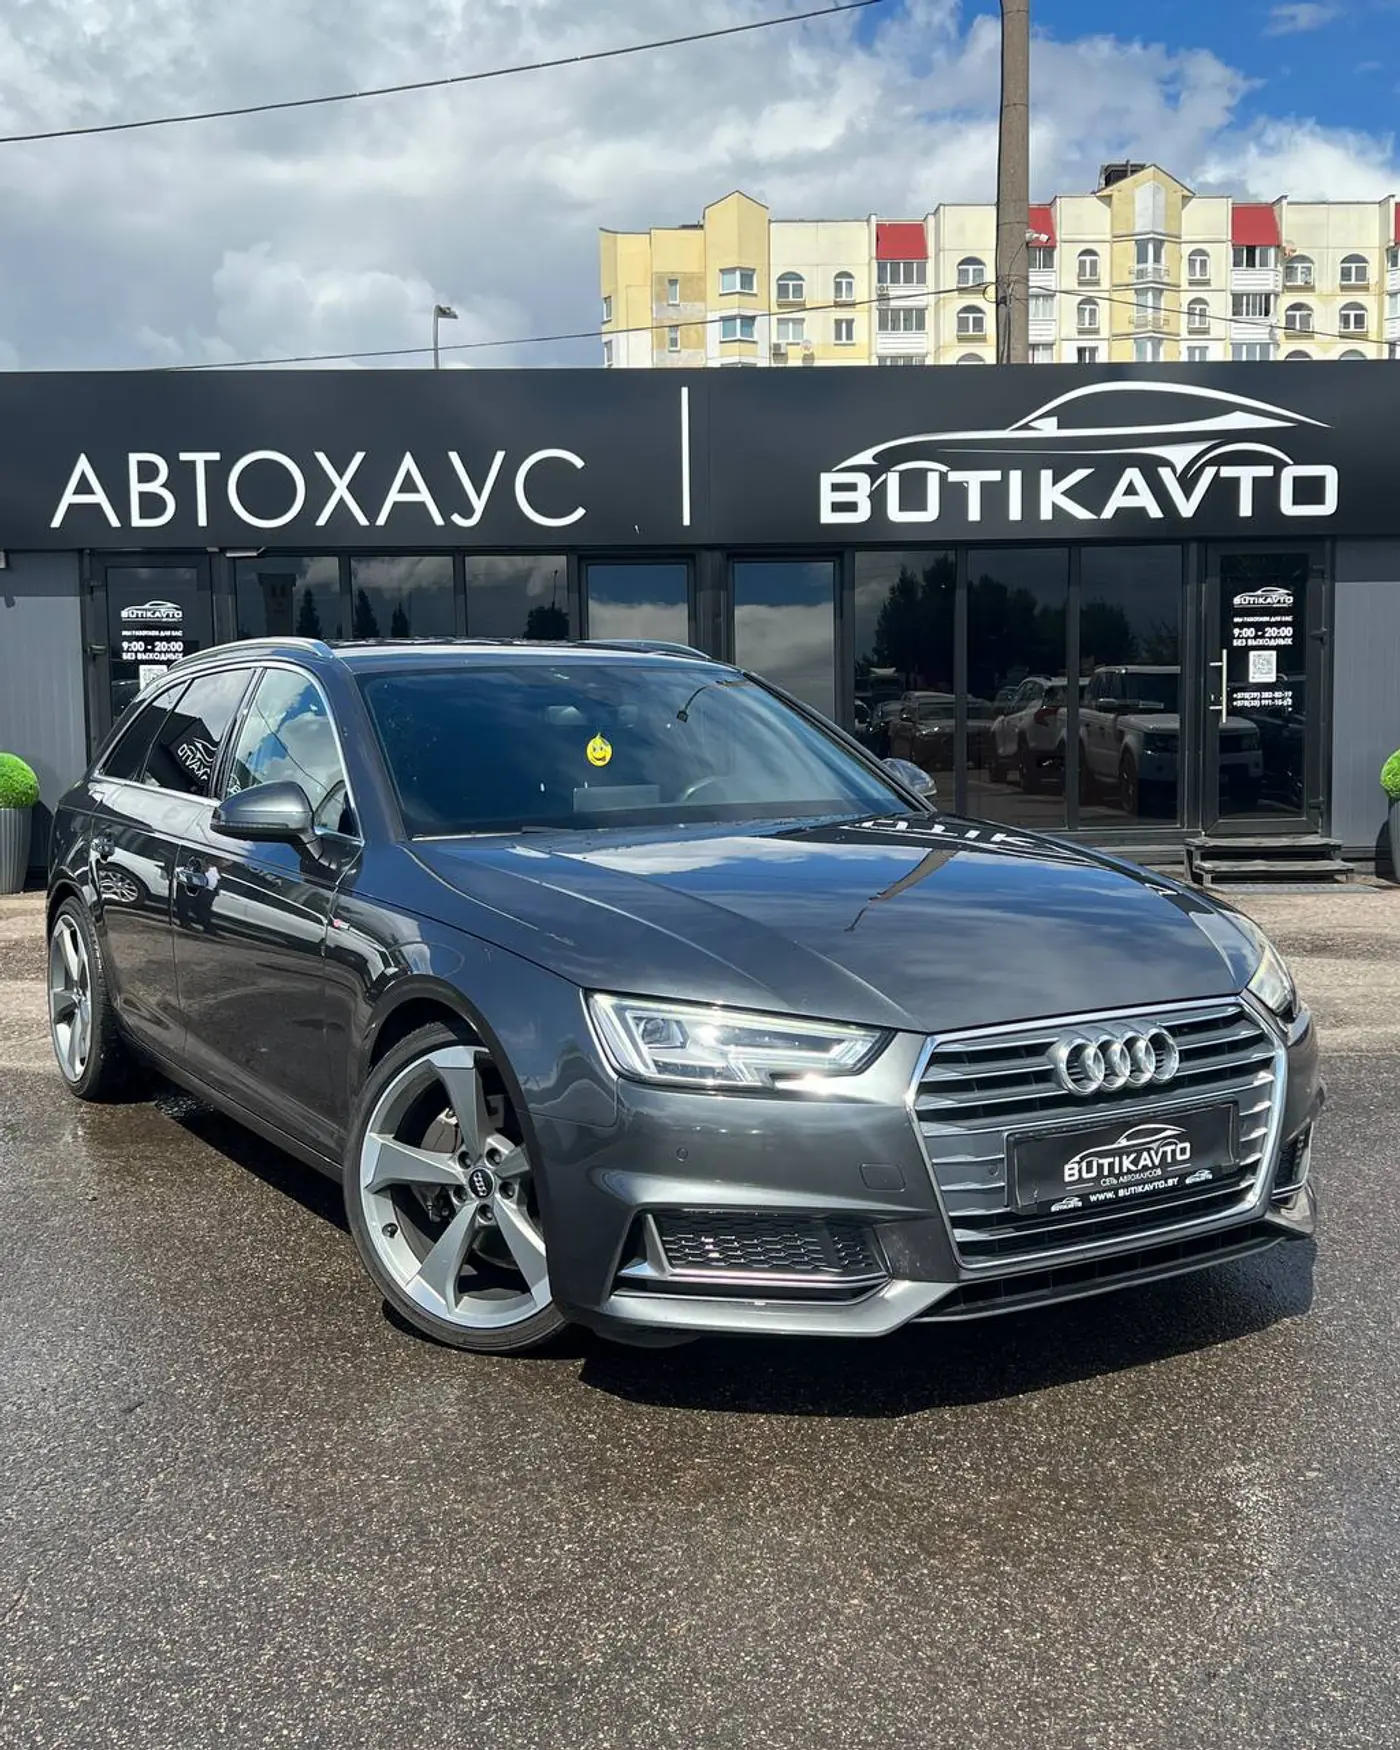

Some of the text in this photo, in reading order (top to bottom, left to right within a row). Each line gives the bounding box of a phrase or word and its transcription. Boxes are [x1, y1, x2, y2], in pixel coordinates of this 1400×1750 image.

[50, 449, 587, 529] АВТОХАУС
[819, 464, 1339, 524] BUTIKAVTO
[1233, 628, 1255, 638] 9:00
[1264, 627, 1293, 637] 20:00
[121, 641, 145, 651] 9:00
[154, 641, 184, 651] 20:00
[1247, 637, 1293, 646] ВЫХОДНЫХ
[121, 652, 184, 661] БЕЗ ВЫХОДНЫХ
[1063, 1142, 1191, 1183] BUTIKAVTO
[1100, 1167, 1162, 1187] СЕТЬ АВТОХАУСОВ
